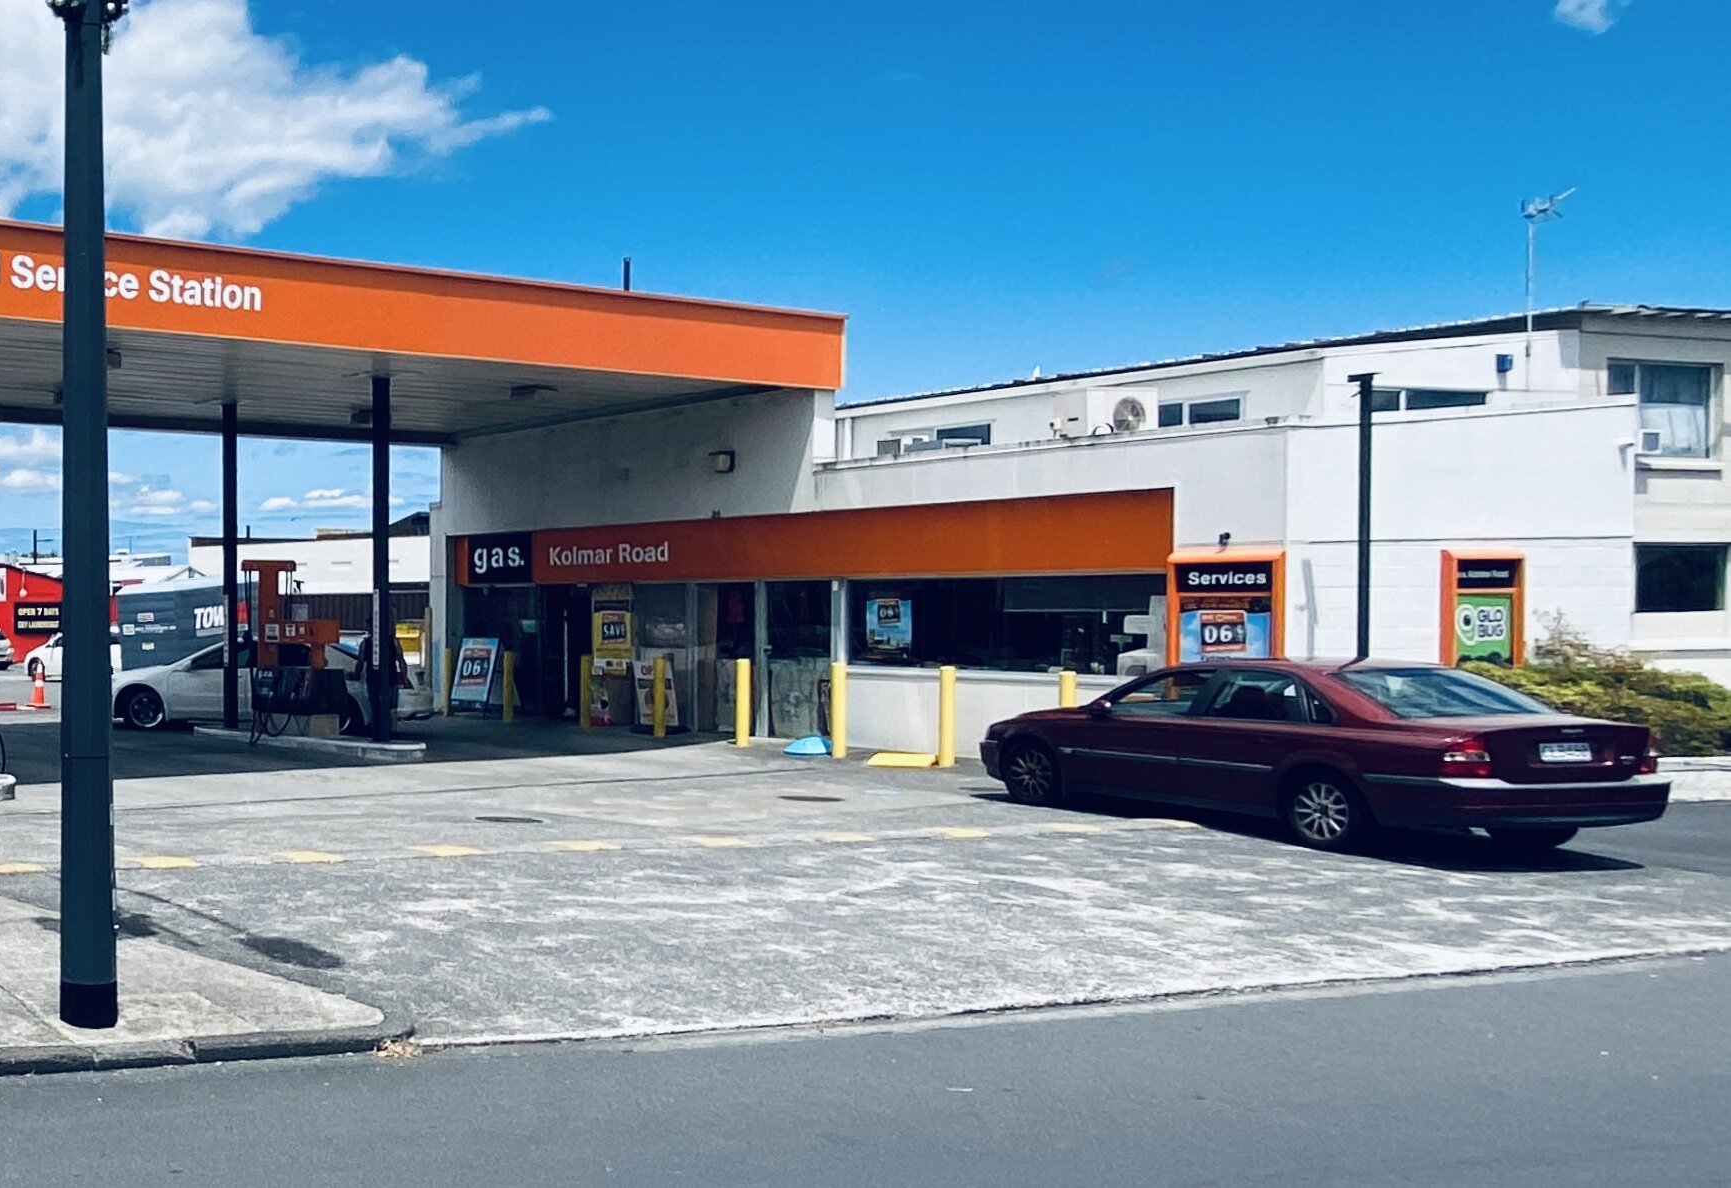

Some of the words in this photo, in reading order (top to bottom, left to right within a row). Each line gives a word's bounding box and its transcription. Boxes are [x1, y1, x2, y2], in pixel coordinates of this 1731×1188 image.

[10, 254, 139, 300] Serce
[148, 268, 263, 312] Station
[548, 546, 613, 566] Kolmar
[618, 541, 669, 564] Road
[1187, 571, 1267, 585] Services
[36, 607, 42, 616] 7
[1477, 609, 1504, 623] GLO
[603, 623, 626, 637] SAVE
[1203, 624, 1233, 644] 06
[1477, 624, 1504, 638] BUG
[462, 660, 481, 677] 06
[640, 664, 654, 676] OP
